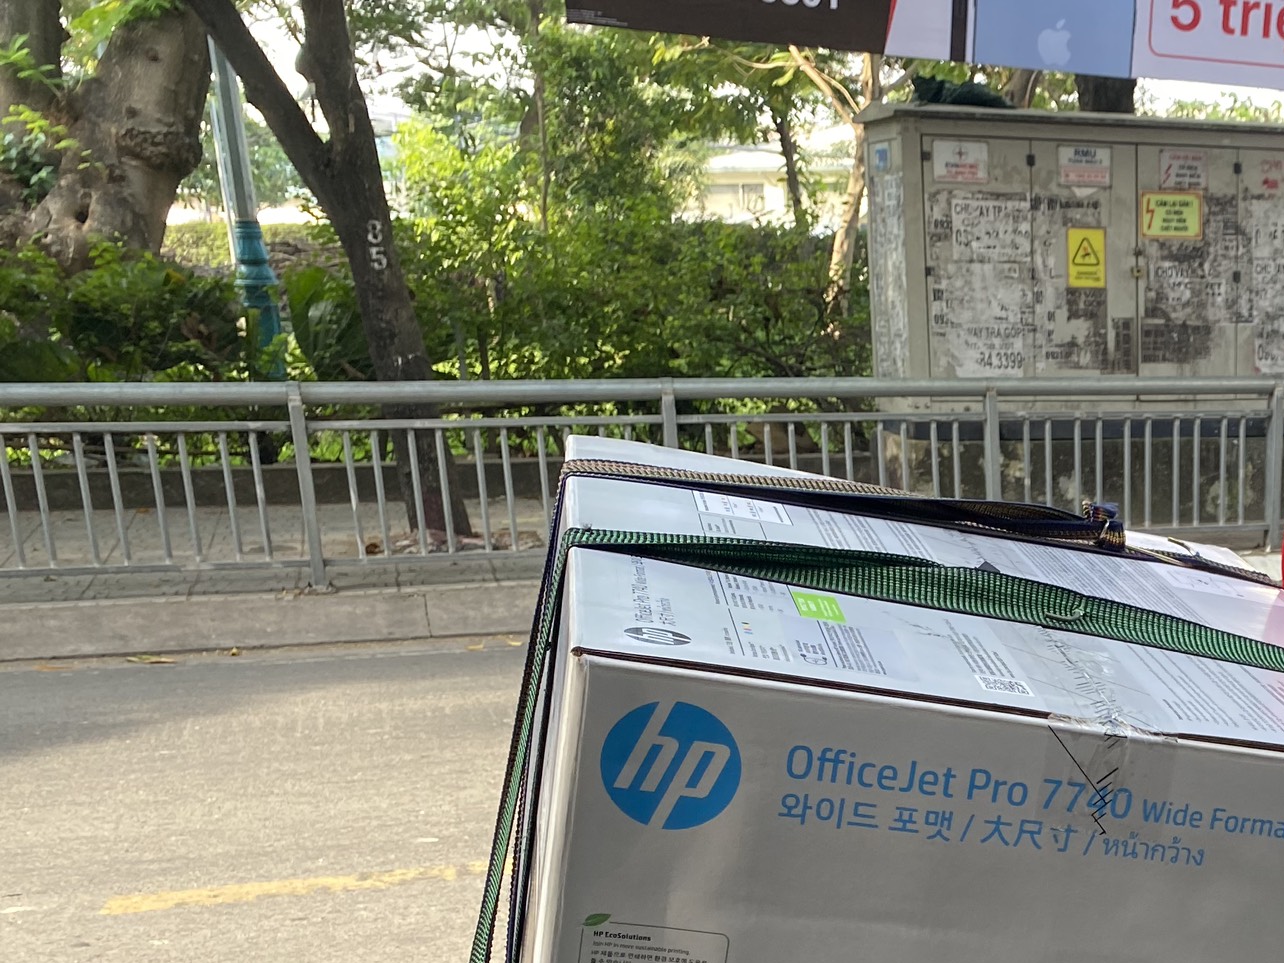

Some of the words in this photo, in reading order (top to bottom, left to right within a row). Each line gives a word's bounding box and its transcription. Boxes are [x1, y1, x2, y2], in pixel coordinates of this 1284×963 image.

[600, 700, 742, 831] hp
[785, 744, 957, 799] OfficeJet
[966, 768, 1029, 807] Pro
[1041, 778, 1133, 819] 7740
[1142, 798, 1204, 829] Wide
[777, 793, 879, 829] 와이드
[888, 805, 953, 842] 포맷
[980, 814, 1079, 853] 大尺寸
[1102, 831, 1206, 867] หน้ากว้าง
[605, 931, 651, 942] EcoSolutions
